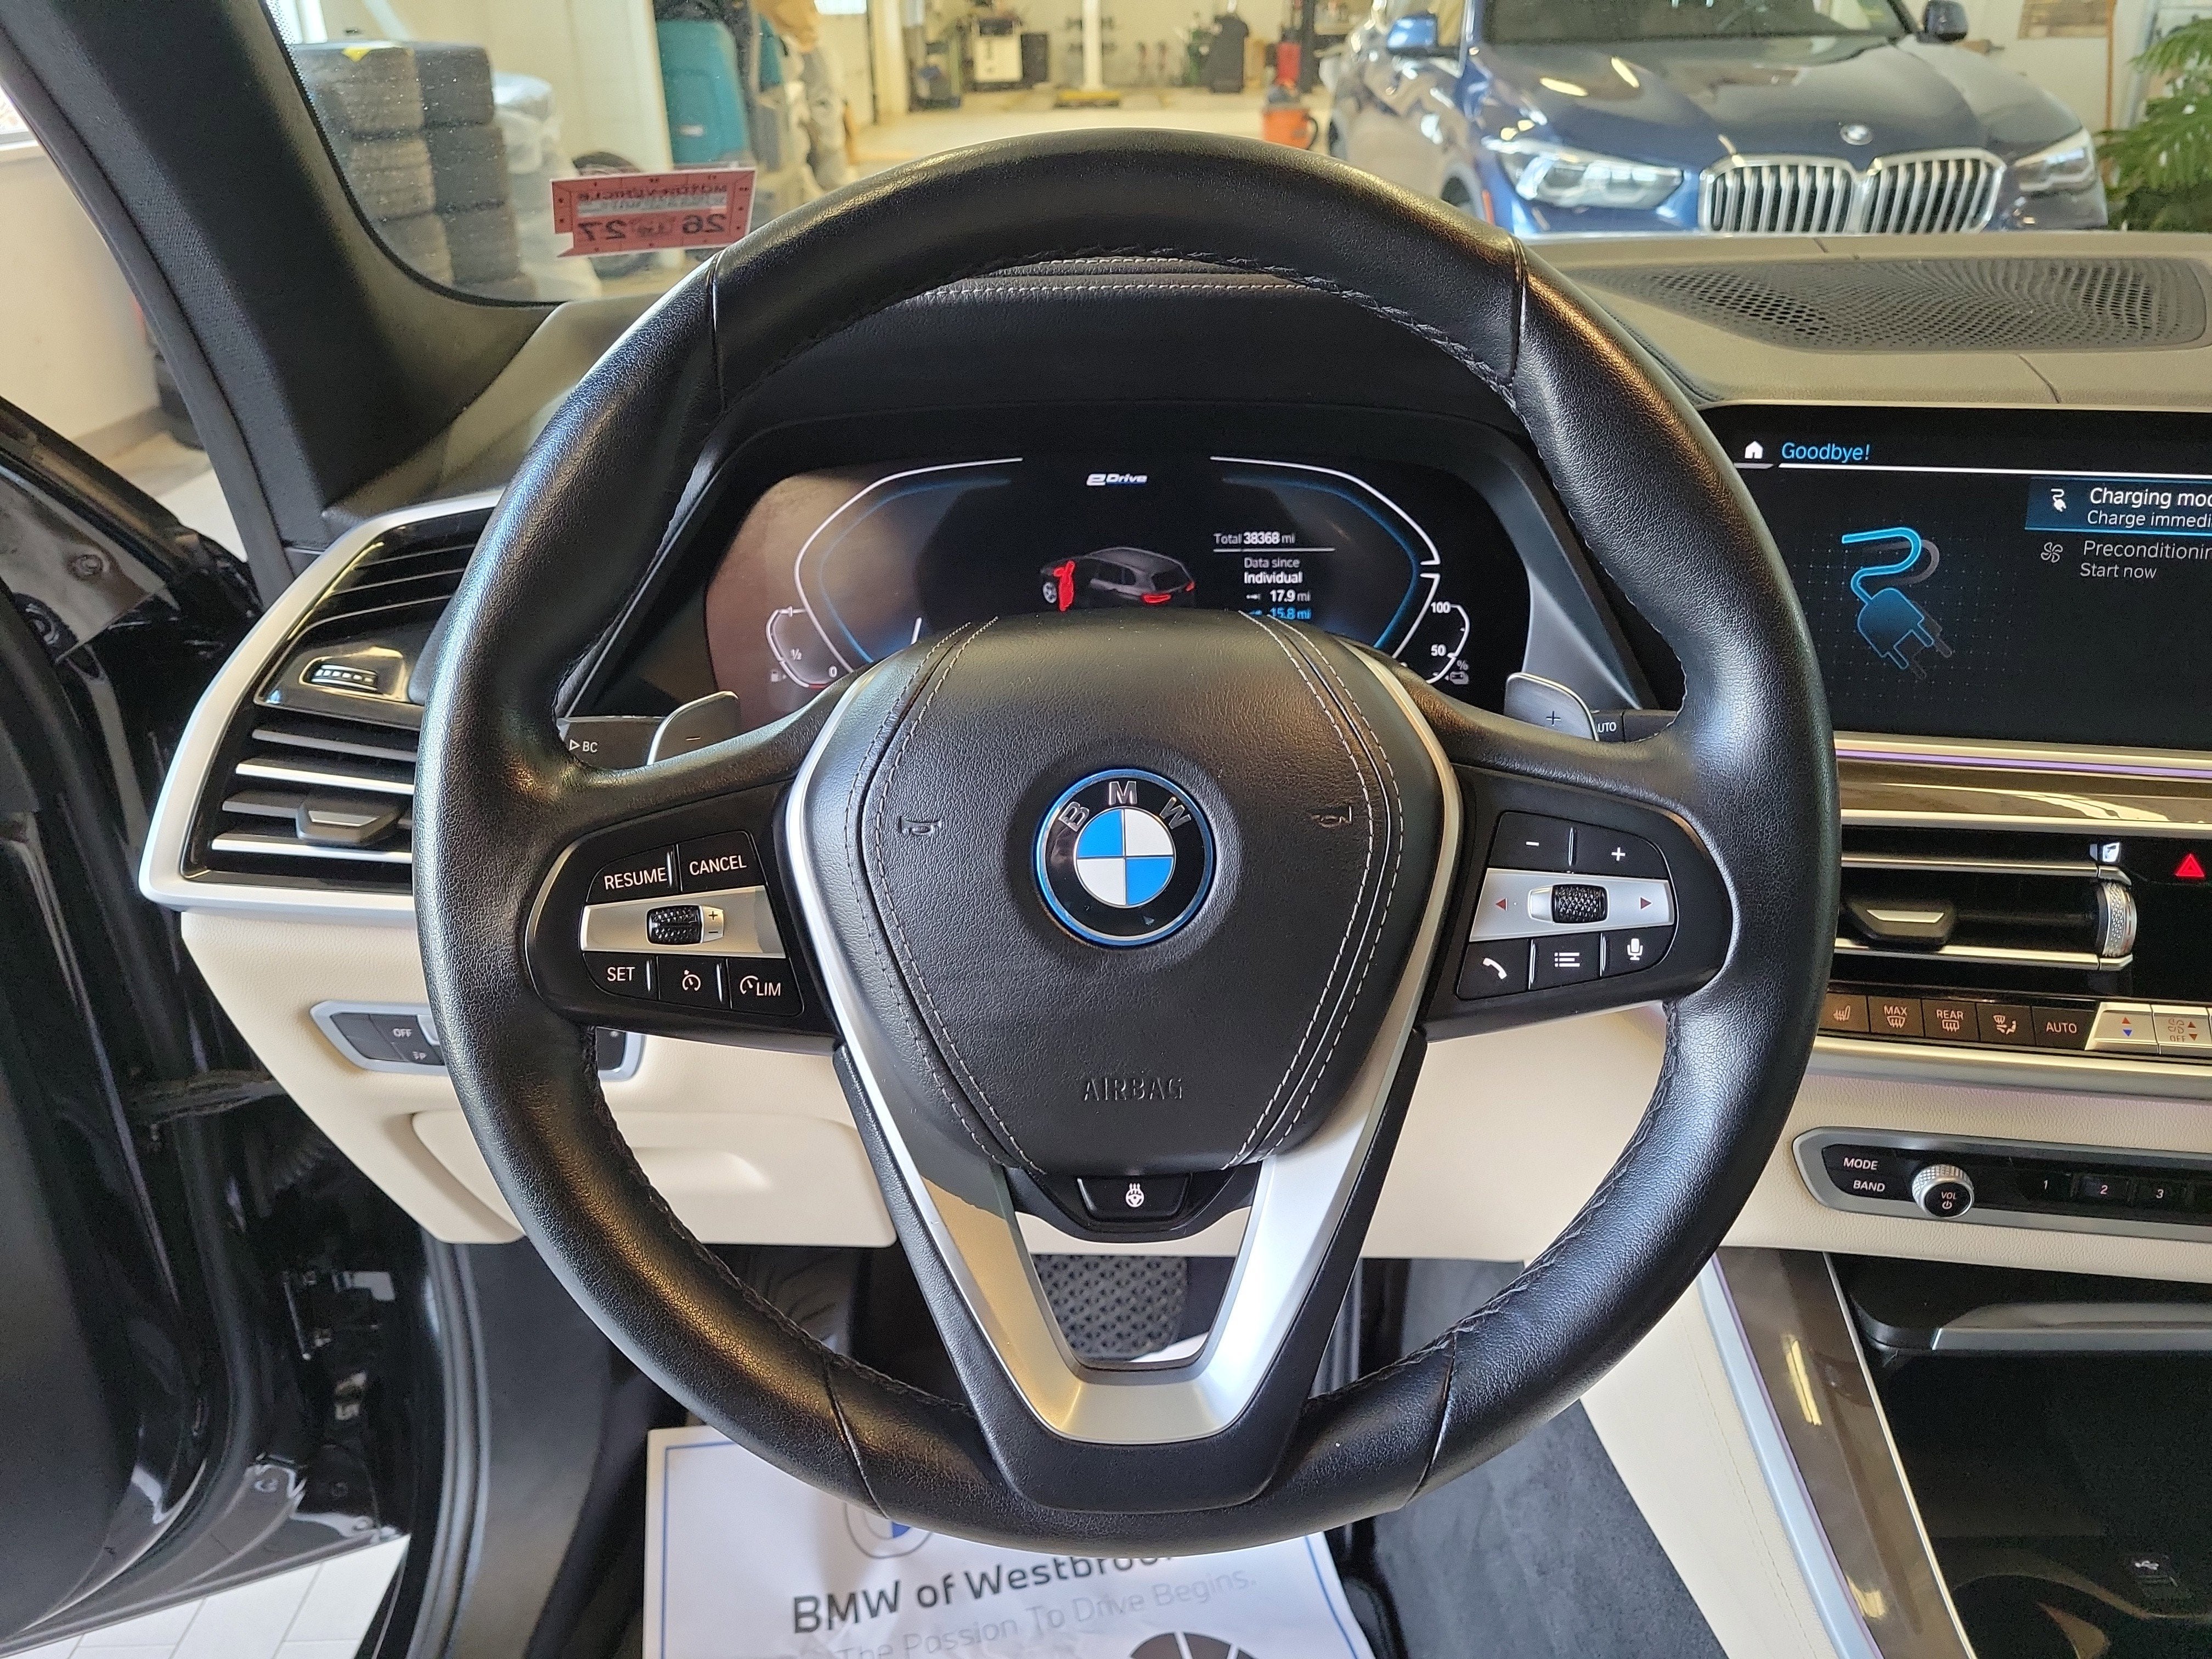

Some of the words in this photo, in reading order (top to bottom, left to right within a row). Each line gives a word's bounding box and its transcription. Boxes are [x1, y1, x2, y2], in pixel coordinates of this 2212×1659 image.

[1781, 441, 1870, 464] Goodbye!
[2090, 487, 2172, 509] Charging
[2087, 509, 2146, 529] Charge
[2151, 511, 2212, 528] immedi
[1213, 532, 1242, 544] Total
[1243, 531, 1280, 544] 38368
[1281, 533, 1296, 544] mi
[1244, 557, 1270, 568] Data
[1271, 557, 1301, 568] since
[2080, 562, 2120, 578] Start
[2123, 566, 2157, 579] now
[1244, 571, 1303, 584] Individual
[1269, 589, 1296, 602] 17.9
[1296, 591, 1312, 602] mi
[1269, 607, 1296, 620] 15.8
[1296, 608, 1312, 620] mi
[1430, 601, 1451, 613] 100
[1430, 644, 1447, 657] 50
[828, 665, 838, 678] 0
[1595, 721, 1617, 733] UTO
[582, 740, 599, 753] BC
[1057, 780, 1192, 833] BMW
[689, 854, 747, 877] CANCEL
[604, 867, 668, 890] RESUME
[606, 966, 636, 983] SET
[756, 981, 782, 997] LIM
[1883, 1005, 1908, 1017] MAX
[1936, 1009, 1965, 1021] REAR
[392, 1028, 413, 1038] OFF
[2045, 1021, 2078, 1034] AUTO
[1082, 1077, 1184, 1102] AIRBAG
[1843, 1156, 1878, 1171] MODE
[1853, 1180, 1886, 1193] BAND
[2043, 1179, 2049, 1190] 1
[2100, 1184, 2109, 1195] 2
[1940, 1191, 1957, 1200] VOL
[2155, 1188, 2165, 1199] 3
[793, 1579, 901, 1634] BMW
[917, 1572, 954, 1609] of
[963, 1556, 1171, 1599] Westbro
[903, 1617, 1019, 1659] Passion
[1025, 1605, 1066, 1634] To
[1072, 1594, 1146, 1623] Drive
[1152, 1567, 1257, 1606] Begins.
